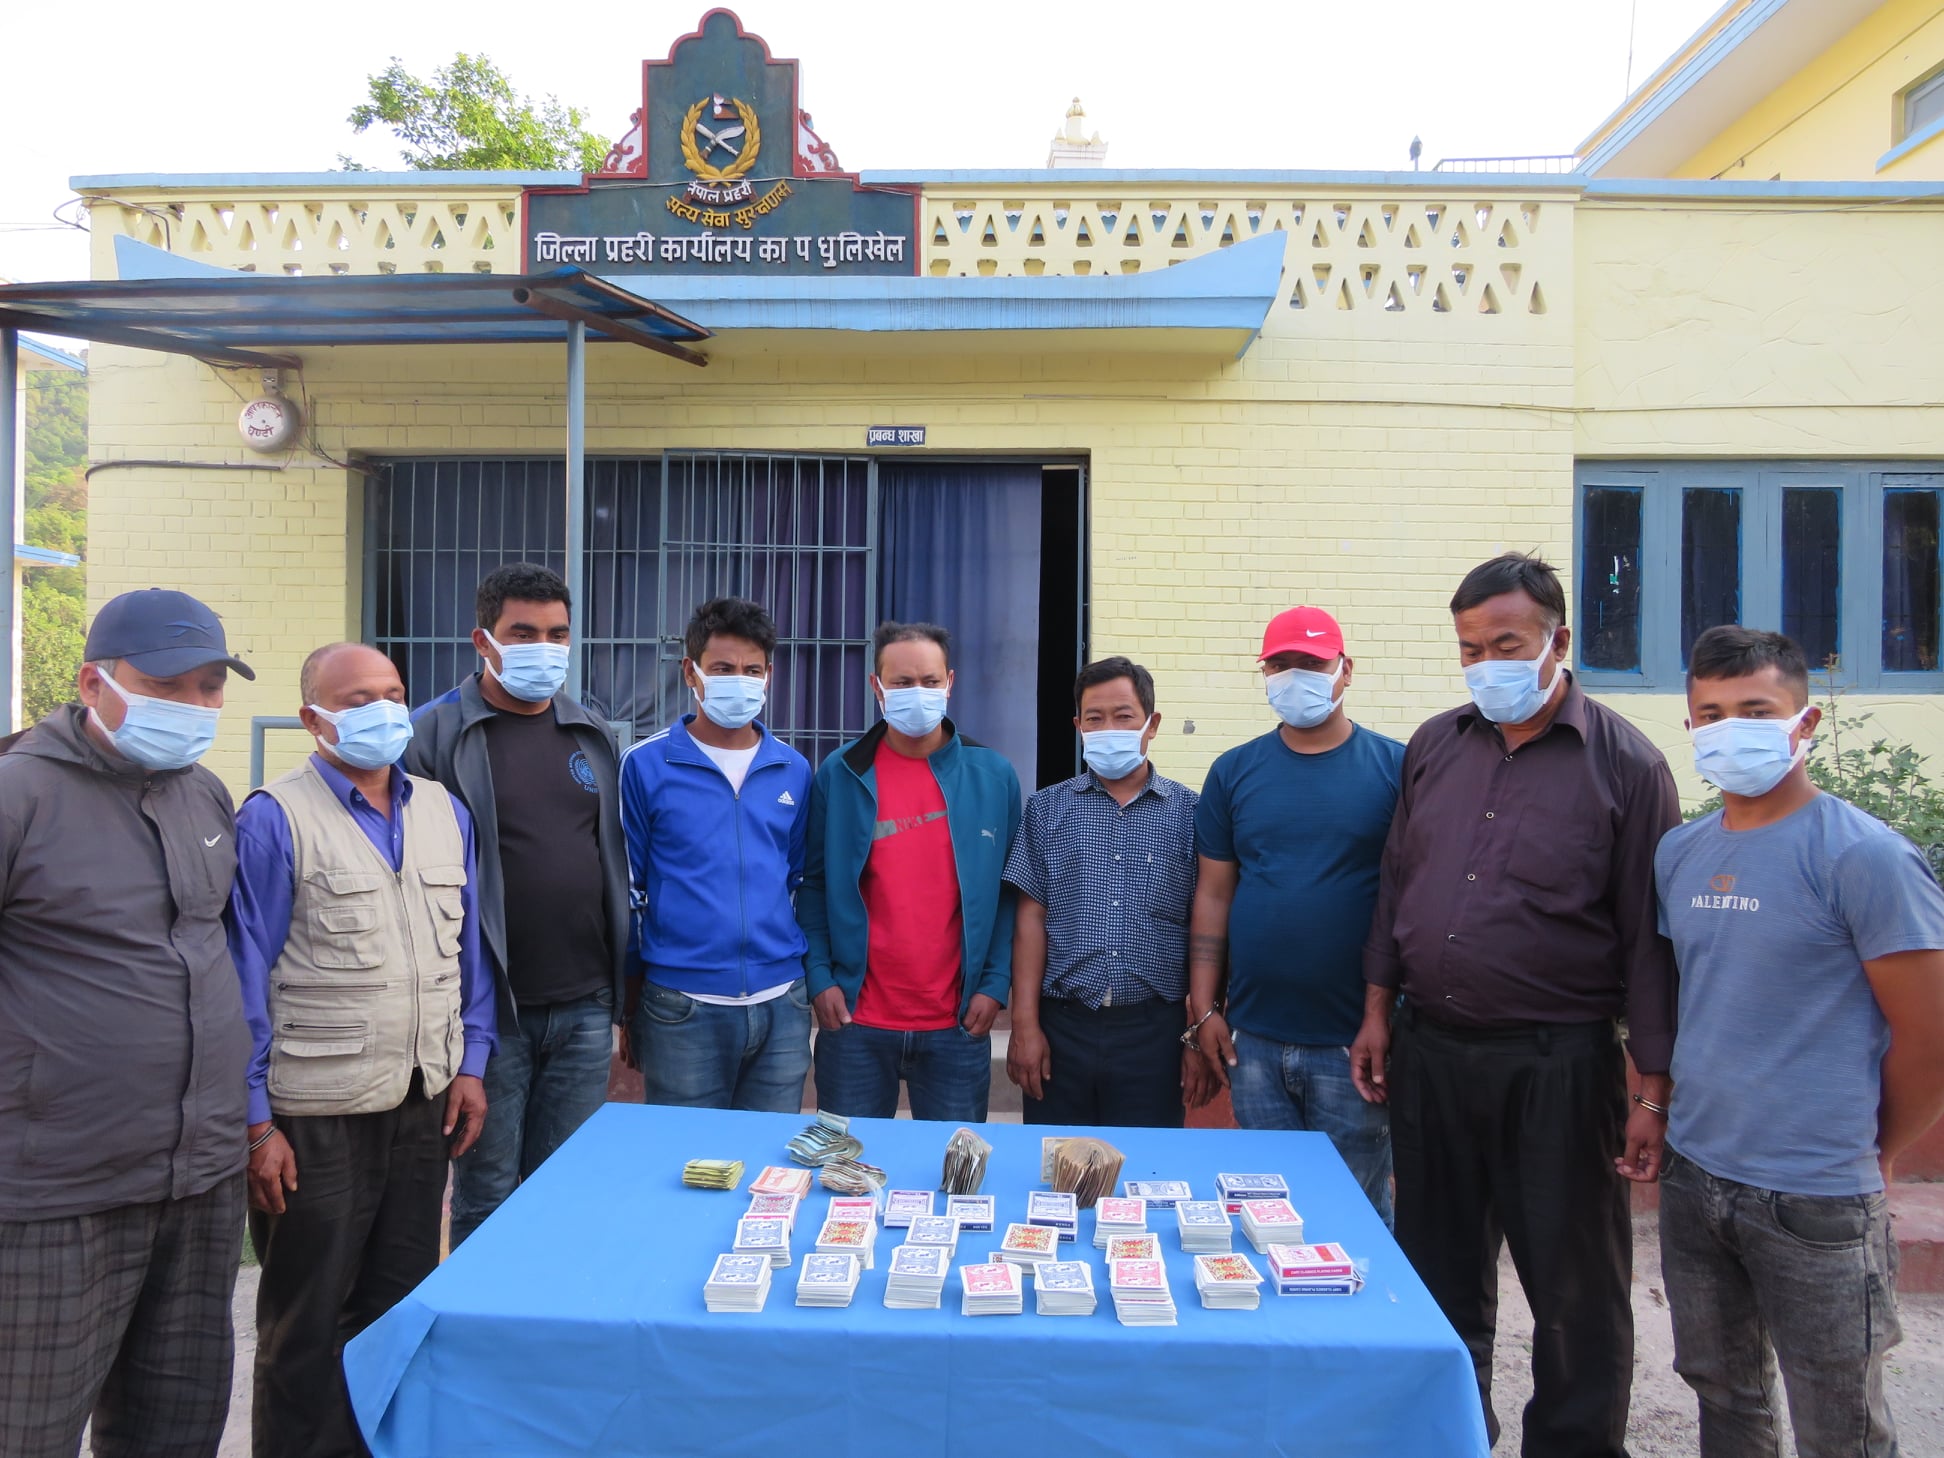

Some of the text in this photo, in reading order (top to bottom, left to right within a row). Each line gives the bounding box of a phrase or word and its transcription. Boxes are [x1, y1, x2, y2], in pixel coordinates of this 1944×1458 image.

[687, 180, 751, 203] नेपाल प्रहरी
[666, 195, 701, 223] सत्य
[701, 208, 730, 227] सेवा
[534, 232, 599, 263] जिल्ला
[603, 231, 655, 263] प्रहरी
[660, 231, 753, 263] कार्यालय
[818, 231, 906, 268] धुलिखेल
